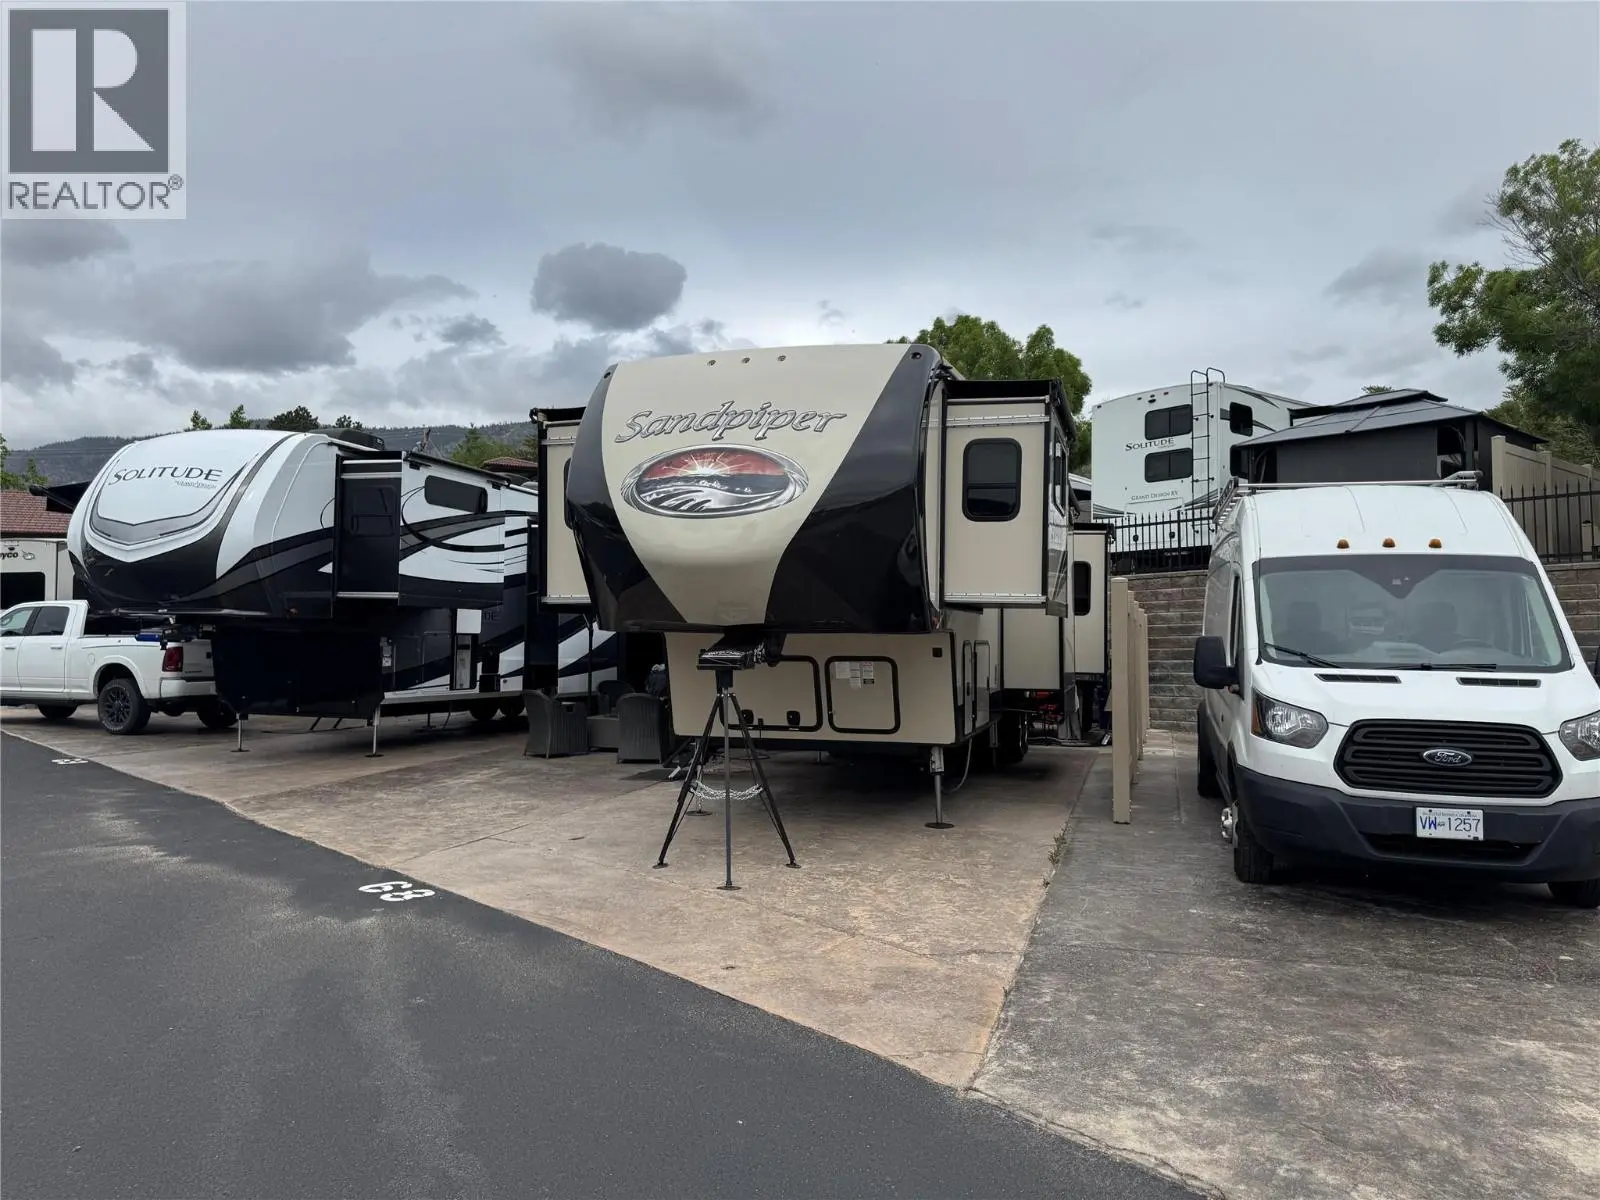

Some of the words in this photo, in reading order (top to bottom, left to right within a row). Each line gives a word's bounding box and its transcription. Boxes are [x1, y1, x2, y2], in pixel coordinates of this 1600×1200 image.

[615, 400, 847, 443] Sandpiper
[1125, 438, 1175, 451] SOLITUDE
[108, 466, 222, 485] SOLITUDE
[1433, 752, 1462, 763] Ford
[1419, 815, 1437, 830] VW
[1447, 817, 1480, 832] 1257
